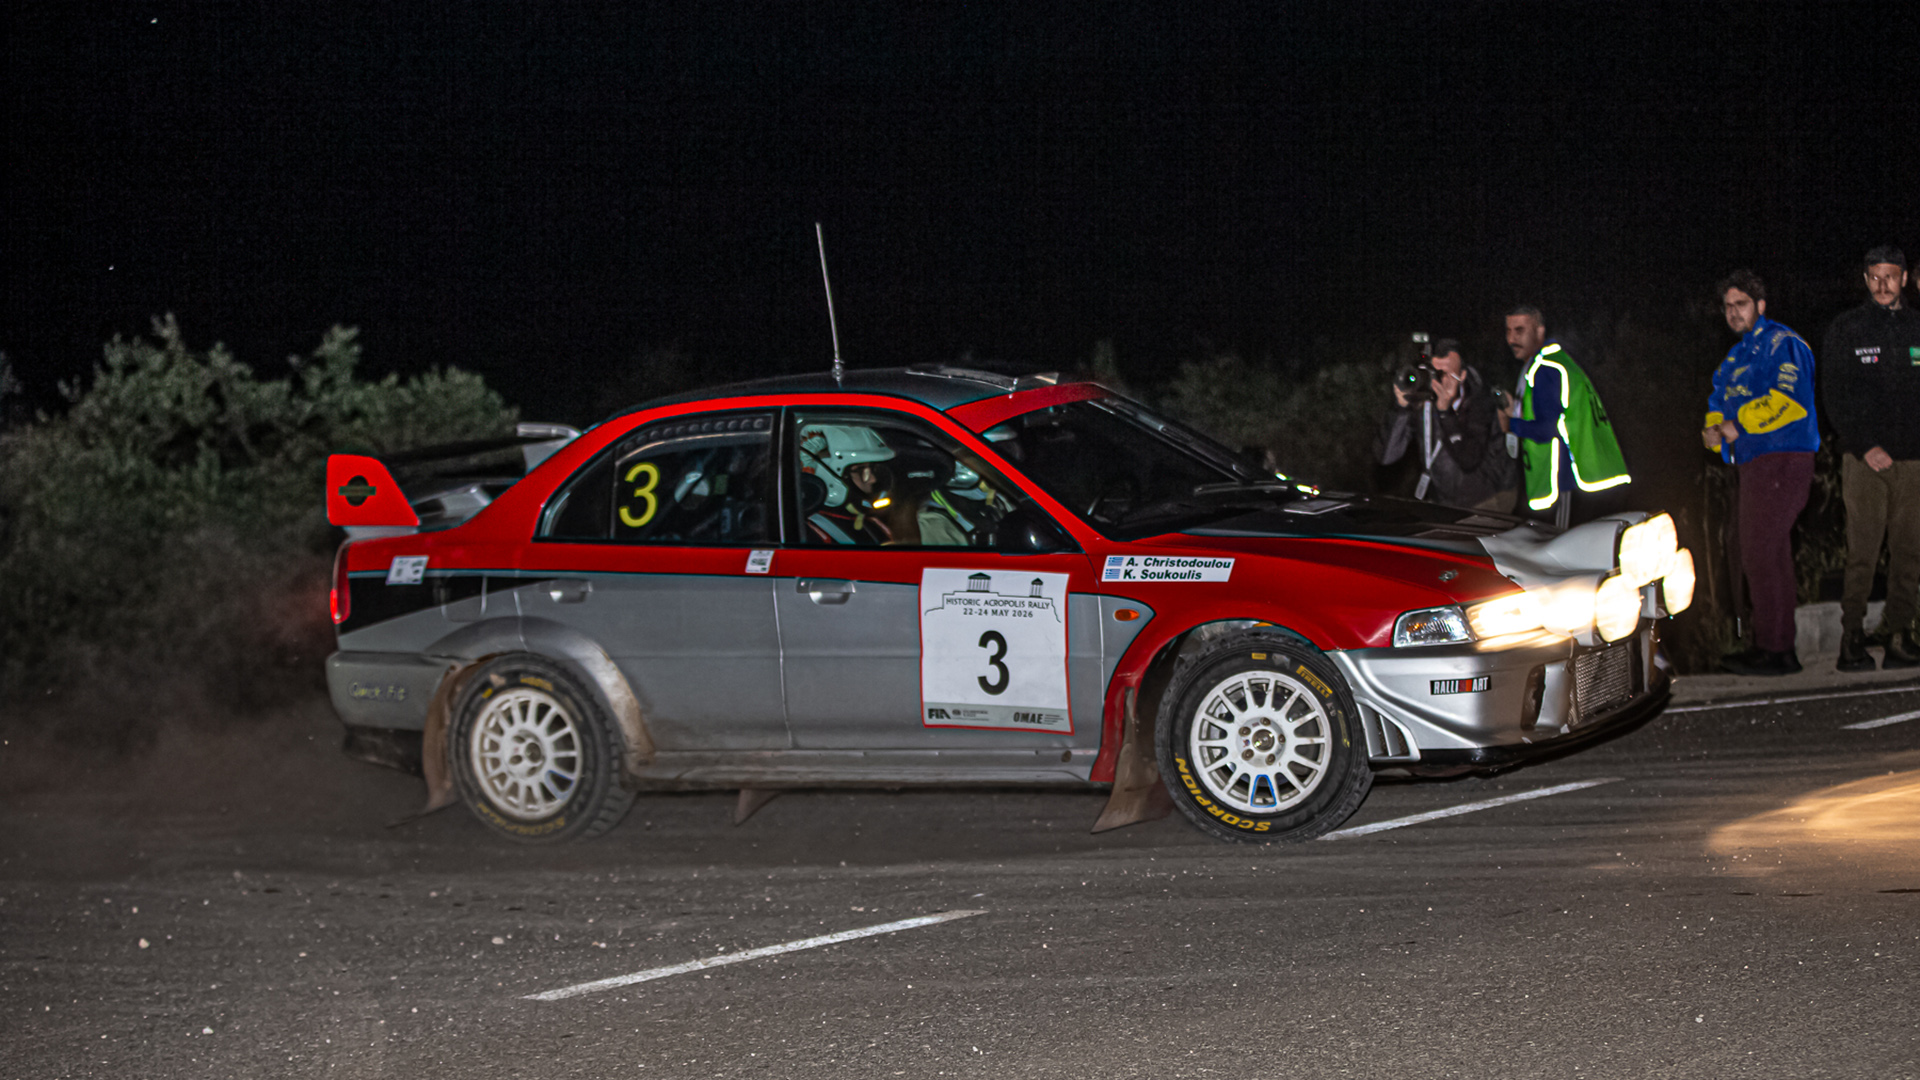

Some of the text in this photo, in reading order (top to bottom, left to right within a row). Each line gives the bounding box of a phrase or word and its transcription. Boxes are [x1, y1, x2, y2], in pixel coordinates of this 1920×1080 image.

[618, 463, 660, 528] 3
[1126, 557, 1231, 569] A. Christodoulou
[1123, 569, 1202, 580] K. Soukoulis
[946, 598, 1050, 609] HISTORIC ACROPOLIS RALLY
[963, 608, 1033, 618] 22-24 MAY 2026
[977, 630, 1010, 695] 3
[1296, 665, 1333, 698] PIRELLI
[928, 708, 951, 720] FIA
[1013, 712, 1043, 724] OMAE
[1174, 756, 1271, 832] SCORPION
